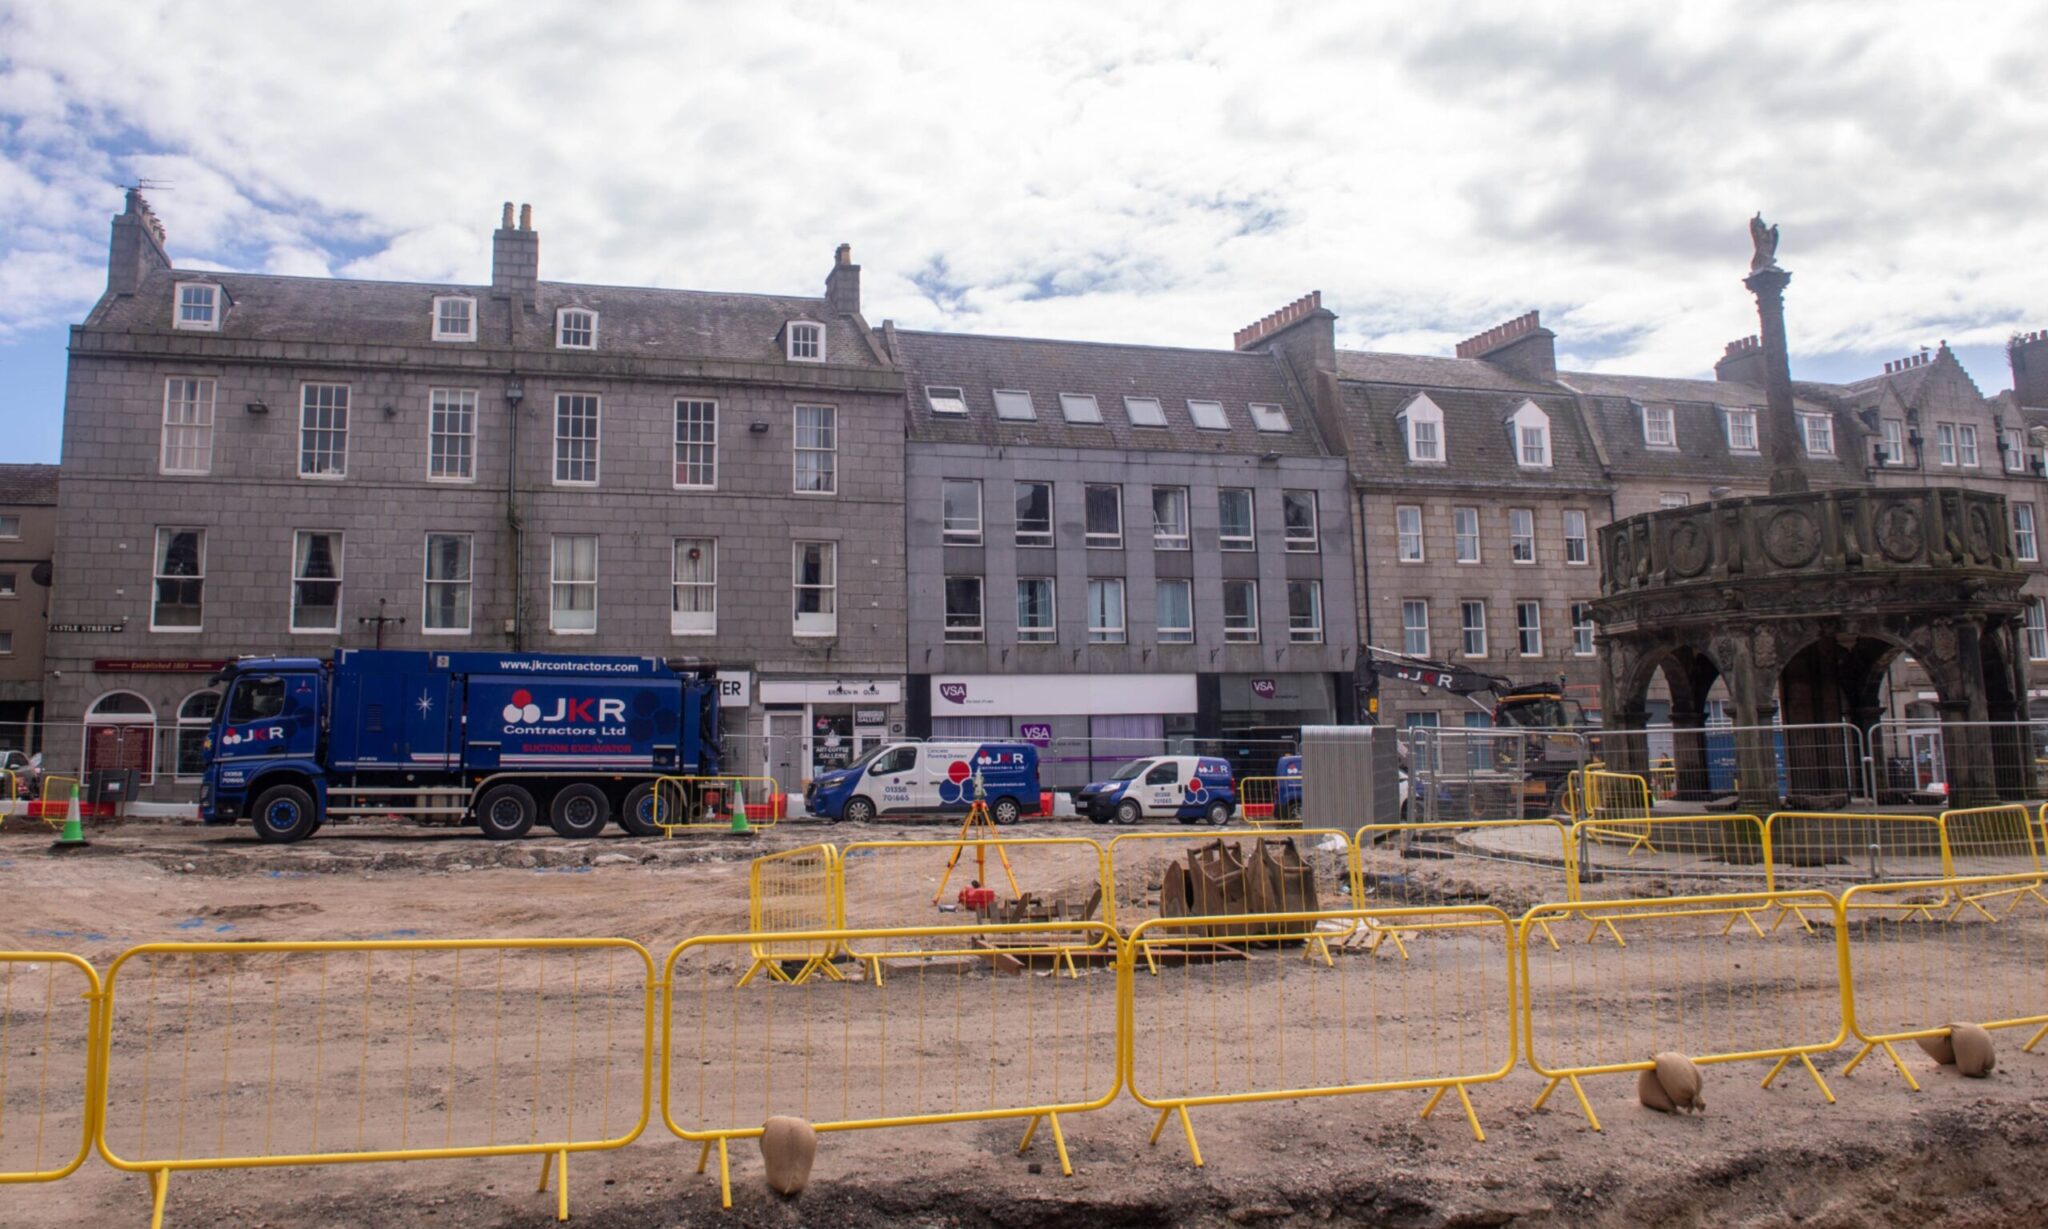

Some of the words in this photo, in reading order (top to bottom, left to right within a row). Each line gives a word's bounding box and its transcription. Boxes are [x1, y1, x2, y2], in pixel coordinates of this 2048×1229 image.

[500, 660, 639, 672] www.jkrcontractors.com
[1409, 670, 1453, 689] JKR
[720, 681, 742, 696] ER
[942, 685, 966, 696] VSA
[1253, 681, 1274, 691] VSA
[542, 697, 626, 722] JKR
[242, 727, 284, 742] JKR
[503, 725, 597, 736] Contractors
[601, 726, 626, 736] Ltd
[1024, 727, 1050, 739] VSA
[523, 744, 568, 752] SUCTION
[571, 744, 632, 752] EXCAVATOR
[993, 753, 1024, 764] JKR
